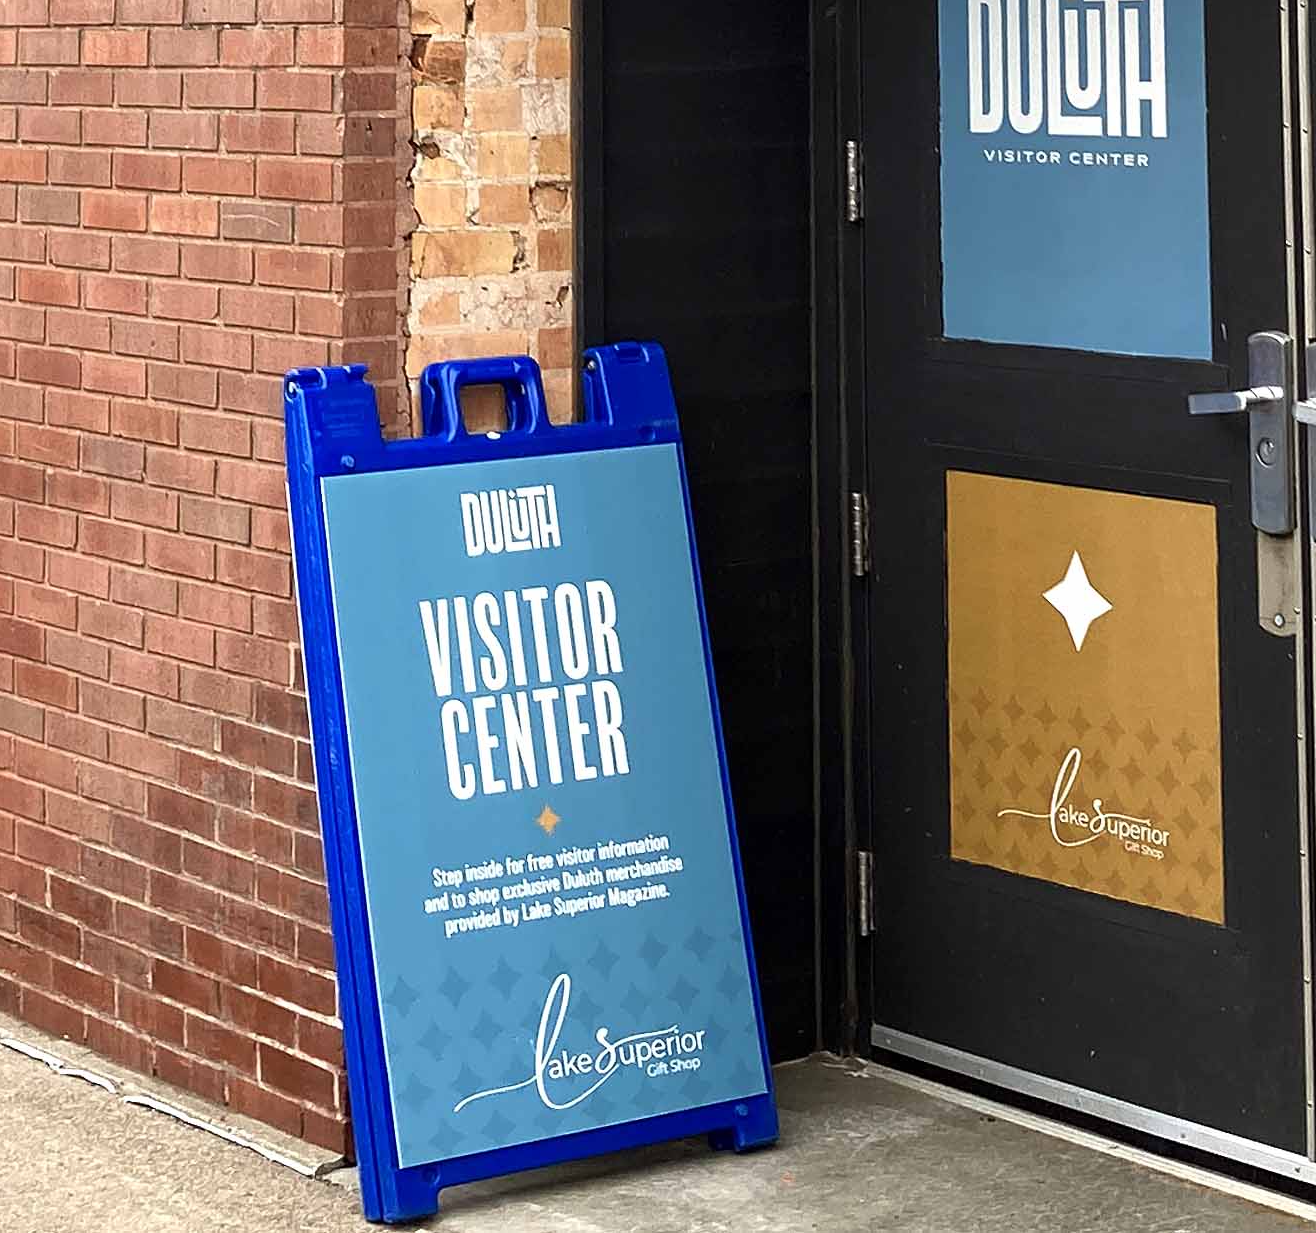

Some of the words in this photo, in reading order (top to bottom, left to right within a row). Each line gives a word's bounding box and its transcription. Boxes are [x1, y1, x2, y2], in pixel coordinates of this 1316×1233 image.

[984, 149, 1061, 164] VISITOR
[1069, 152, 1149, 167] CENTER
[460, 484, 562, 557] DULUTH
[419, 580, 624, 697] VISITOR
[440, 680, 630, 800] CENTER
[1089, 798, 1169, 847] Superior
[424, 893, 449, 914] and
[452, 892, 466, 909] to
[468, 886, 500, 907] shop
[502, 876, 561, 900] exclusive
[562, 867, 604, 891] Duluth
[605, 855, 683, 883] merchandise
[432, 868, 463, 888] Step
[465, 860, 504, 881] inside
[506, 858, 525, 875] for
[526, 854, 554, 872] free
[556, 846, 596, 866] visitor
[597, 834, 670, 860] information
[444, 908, 501, 939] provided
[503, 906, 520, 927] by
[521, 901, 552, 921] Lake
[553, 892, 606, 917] Superior
[607, 882, 670, 907] Magazine.
[594, 1025, 706, 1075] Superior
[646, 1062, 670, 1078] Gift
[671, 1056, 701, 1076] Shop
